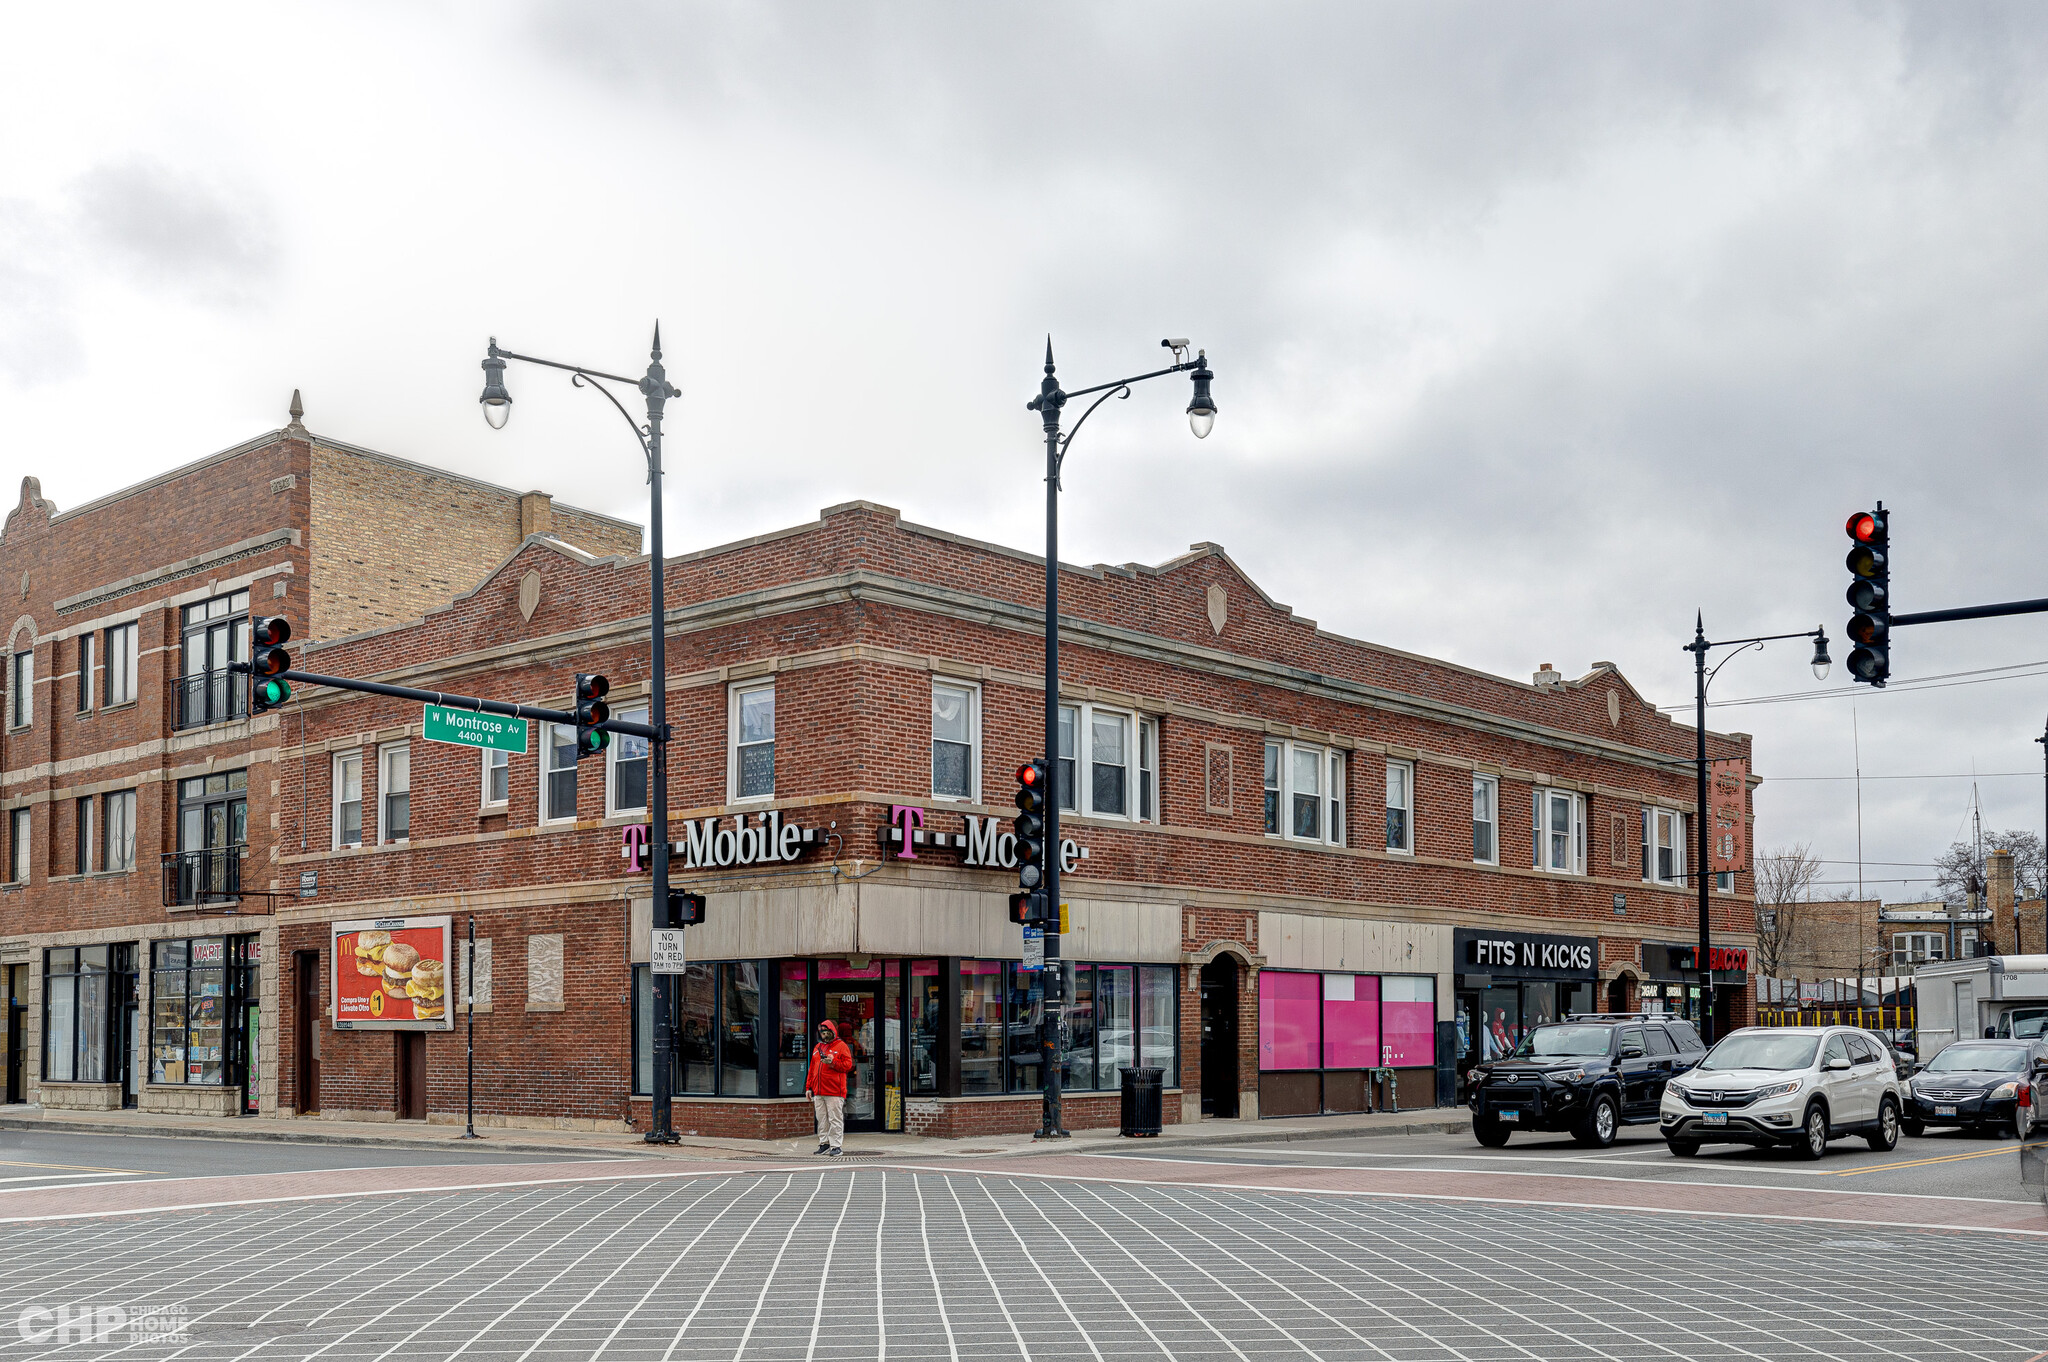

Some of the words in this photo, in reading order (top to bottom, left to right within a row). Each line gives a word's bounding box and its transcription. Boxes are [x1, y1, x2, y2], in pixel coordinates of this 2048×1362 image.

[433, 712, 440, 721] W
[446, 712, 502, 733] Montrose
[507, 724, 520, 734] Av
[458, 731, 482, 742] 4400
[488, 735, 494, 744] N
[662, 933, 673, 941] NO
[658, 943, 677, 951] TURN
[194, 944, 222, 961] MART
[653, 952, 664, 960] ON
[1477, 939, 1516, 966] FITS
[1523, 942, 1535, 967] N
[1541, 943, 1592, 969] KICKS
[1692, 946, 1748, 971] TBACCO
[340, 996, 357, 1004] Compra
[842, 994, 859, 1003] 4001
[358, 1004, 369, 1012] Otro
